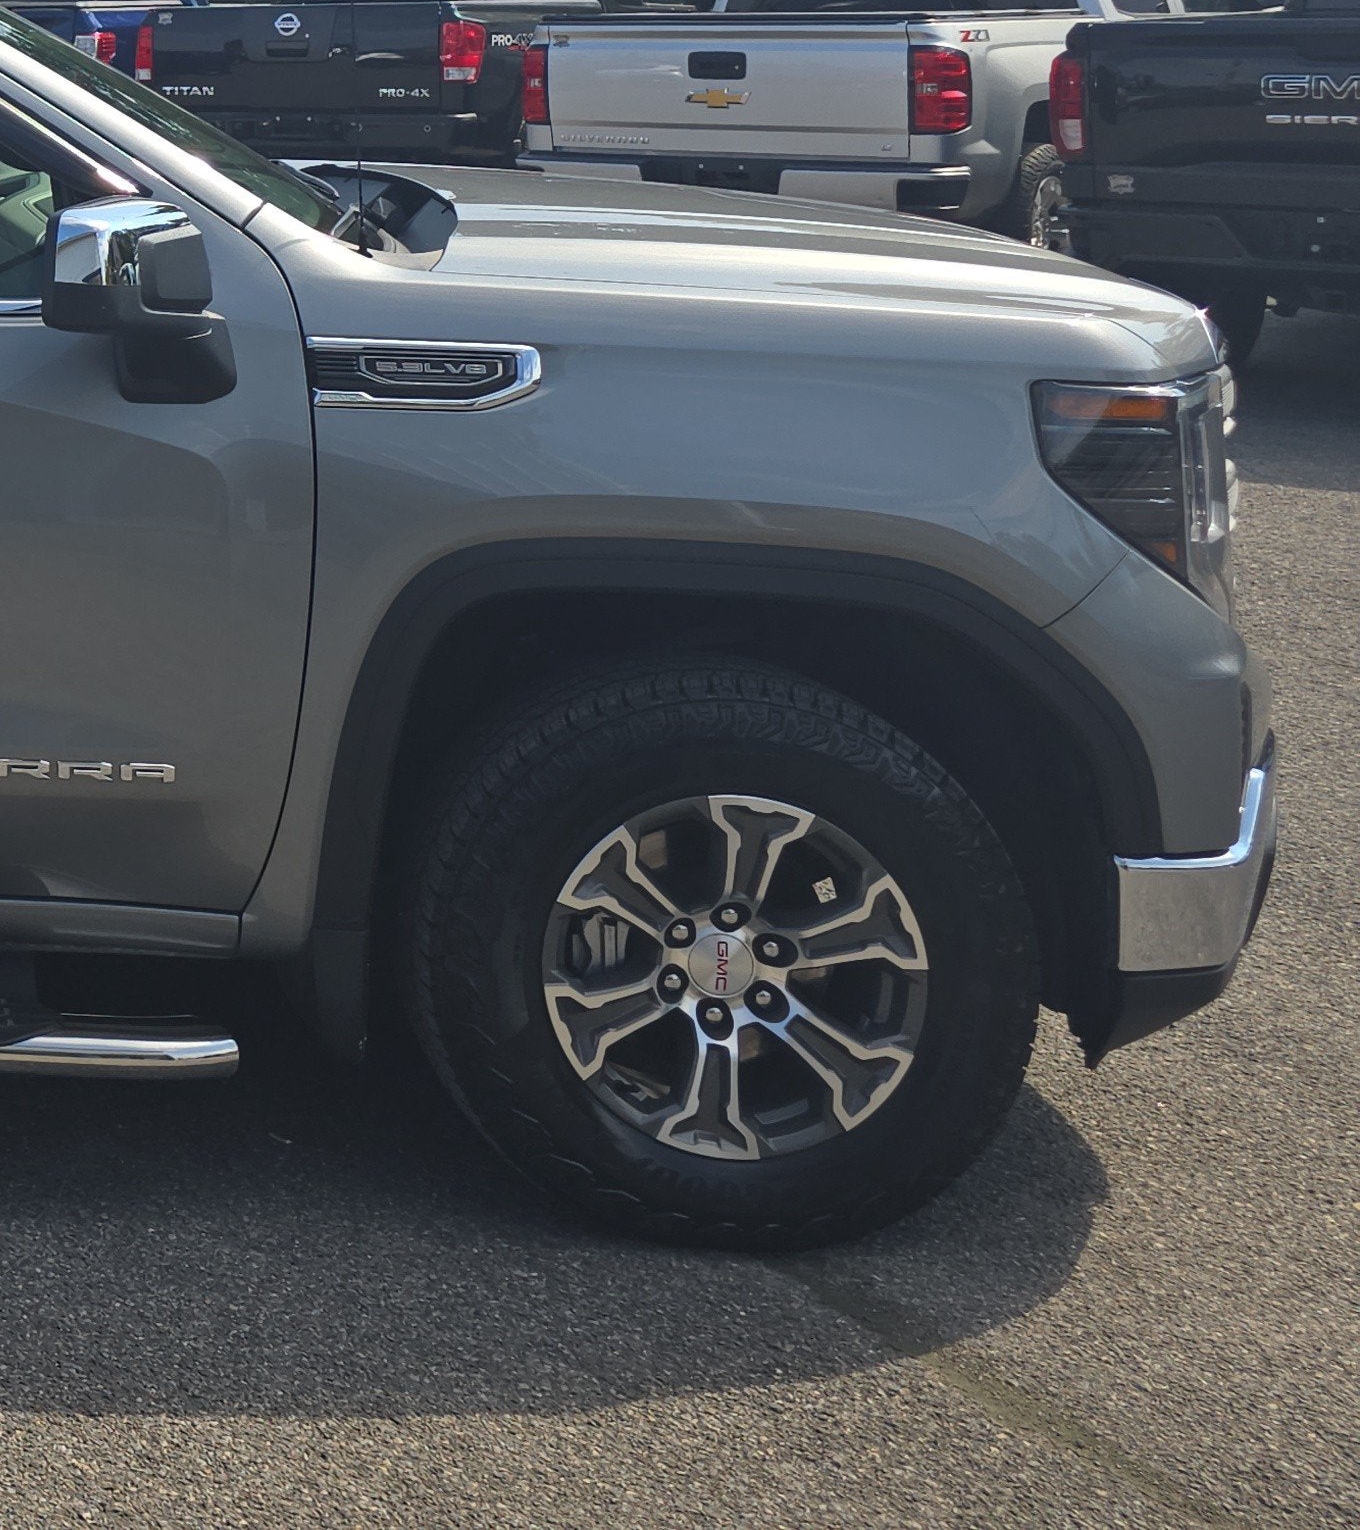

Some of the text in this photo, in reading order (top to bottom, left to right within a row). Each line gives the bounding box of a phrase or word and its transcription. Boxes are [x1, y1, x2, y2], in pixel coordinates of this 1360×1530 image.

[958, 29, 990, 42] Z71
[162, 85, 215, 96] TITAN
[714, 940, 729, 992] GMC
